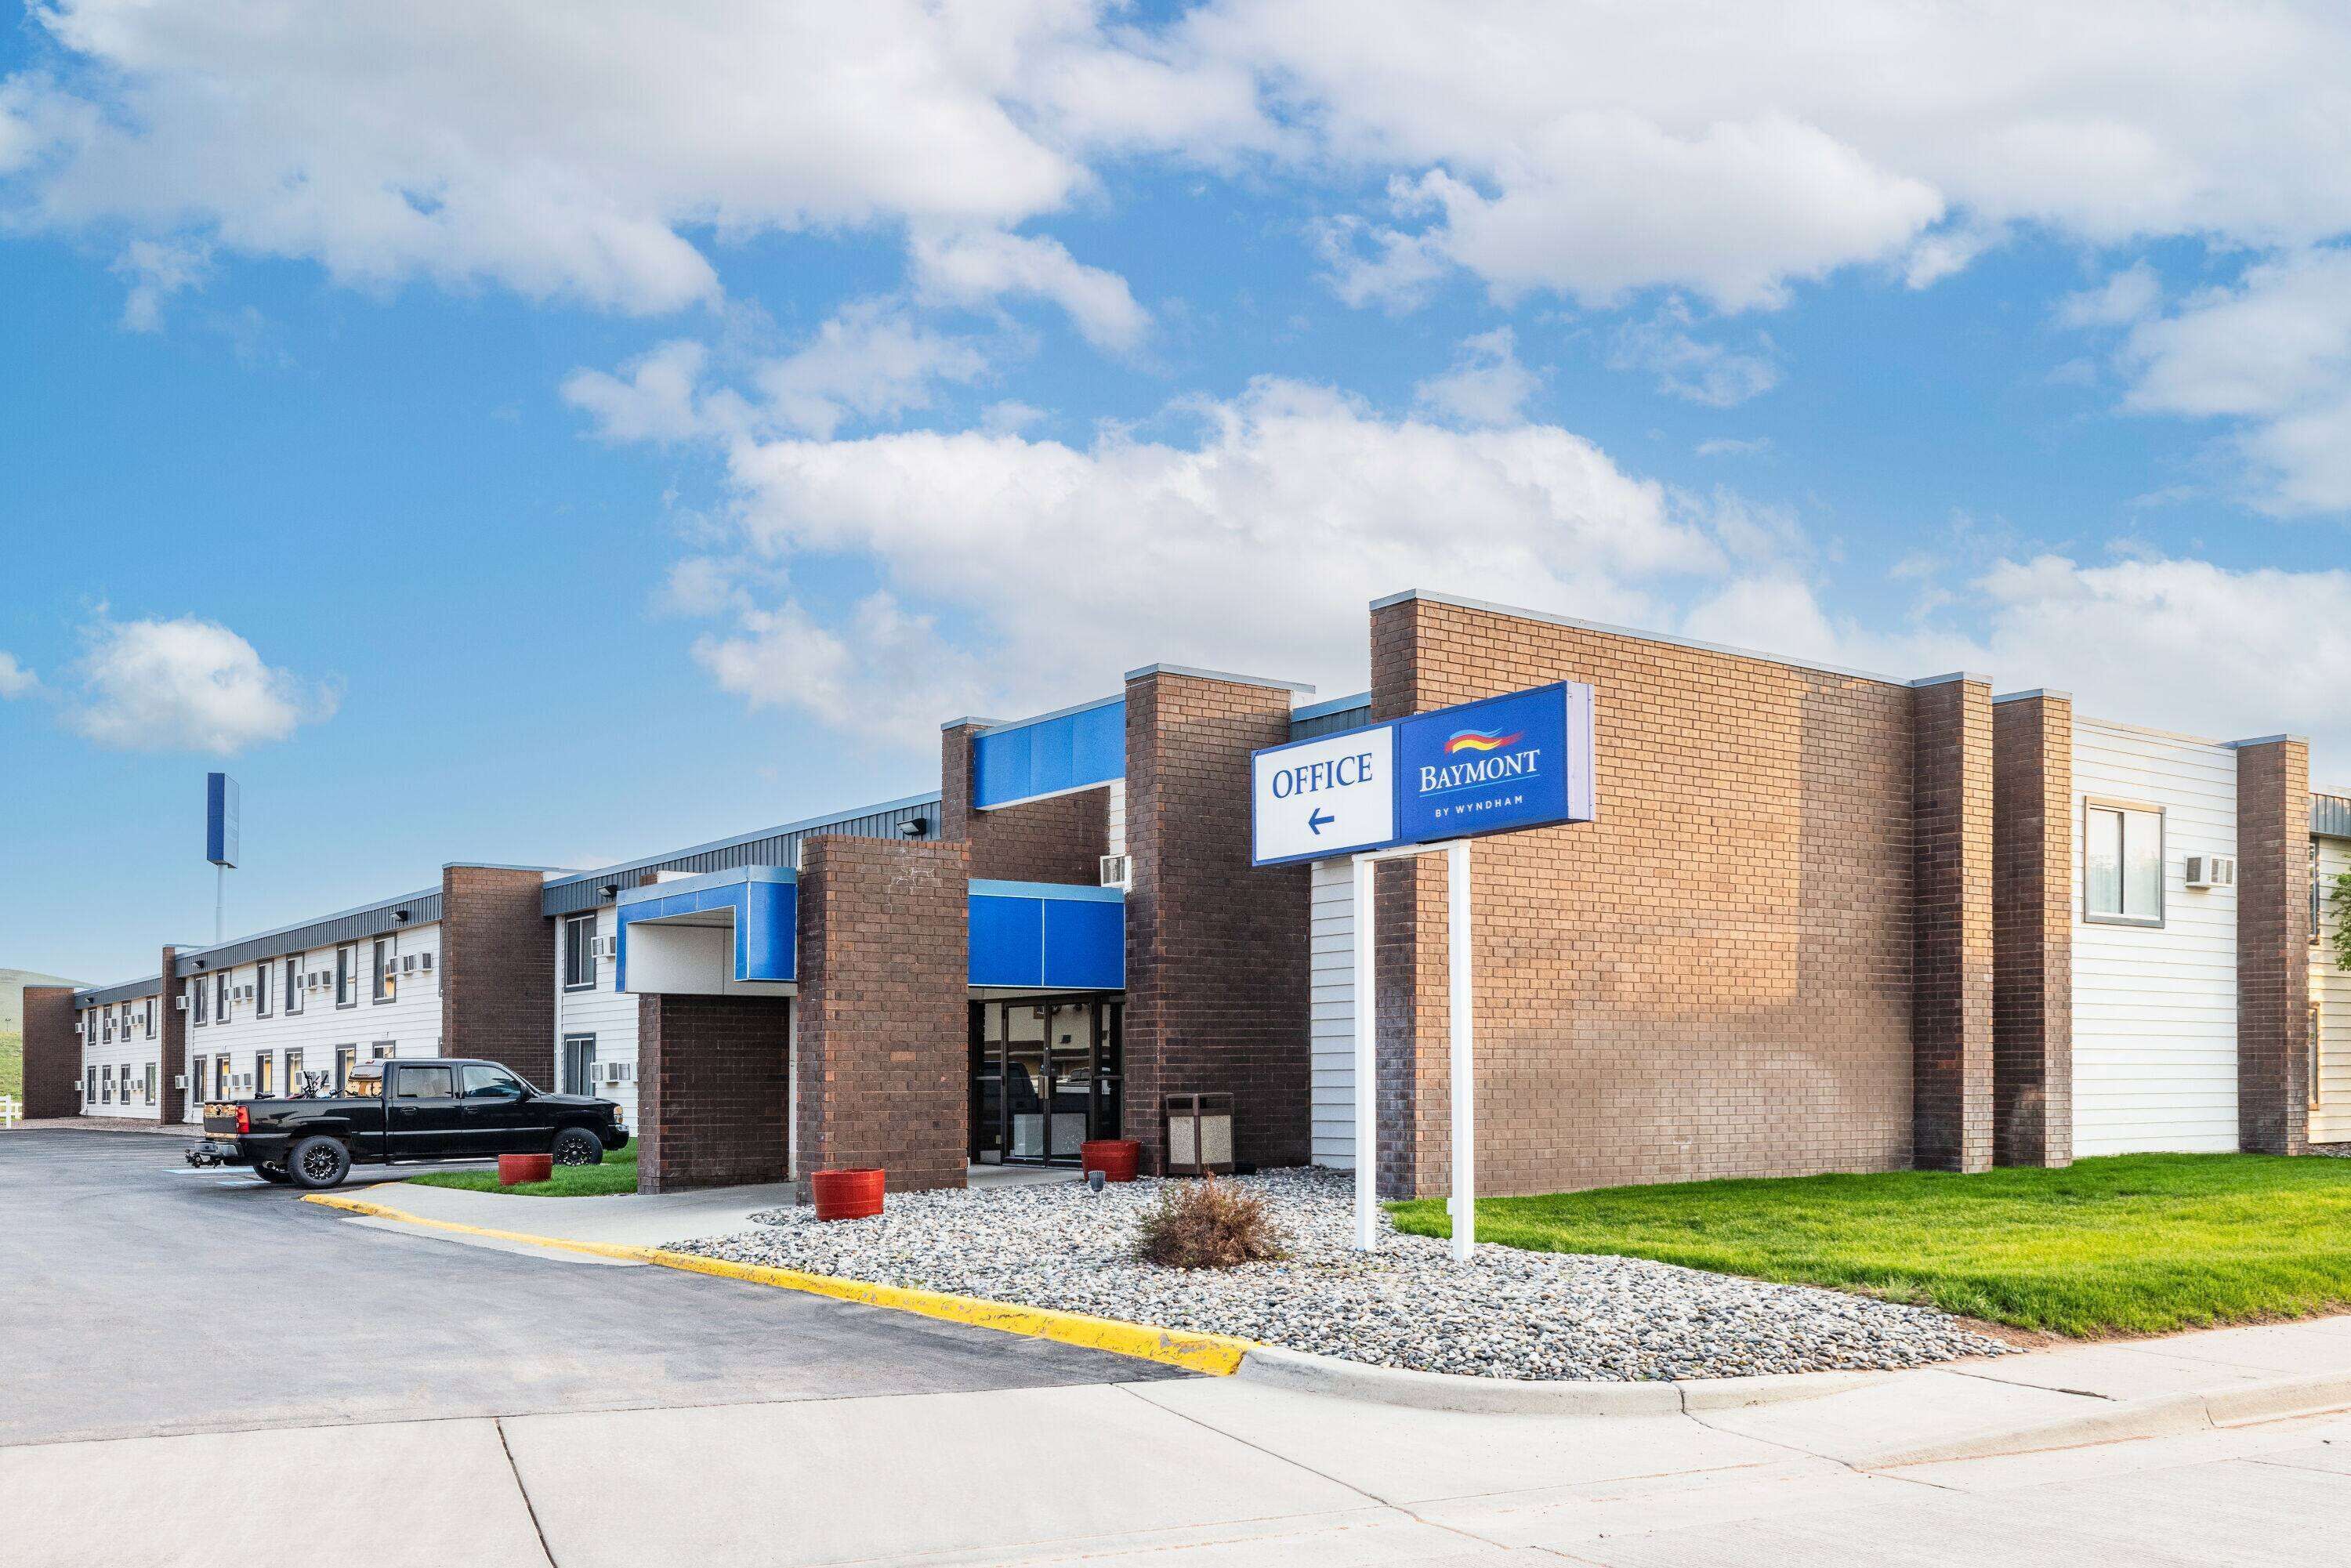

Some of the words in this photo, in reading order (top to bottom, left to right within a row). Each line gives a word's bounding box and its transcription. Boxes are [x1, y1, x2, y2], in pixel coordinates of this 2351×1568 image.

[1272, 752, 1373, 799] OFFICE
[1419, 749, 1541, 792] BAYMONT
[1435, 808, 1449, 818] BY
[1455, 795, 1523, 814] WYNDHAM
